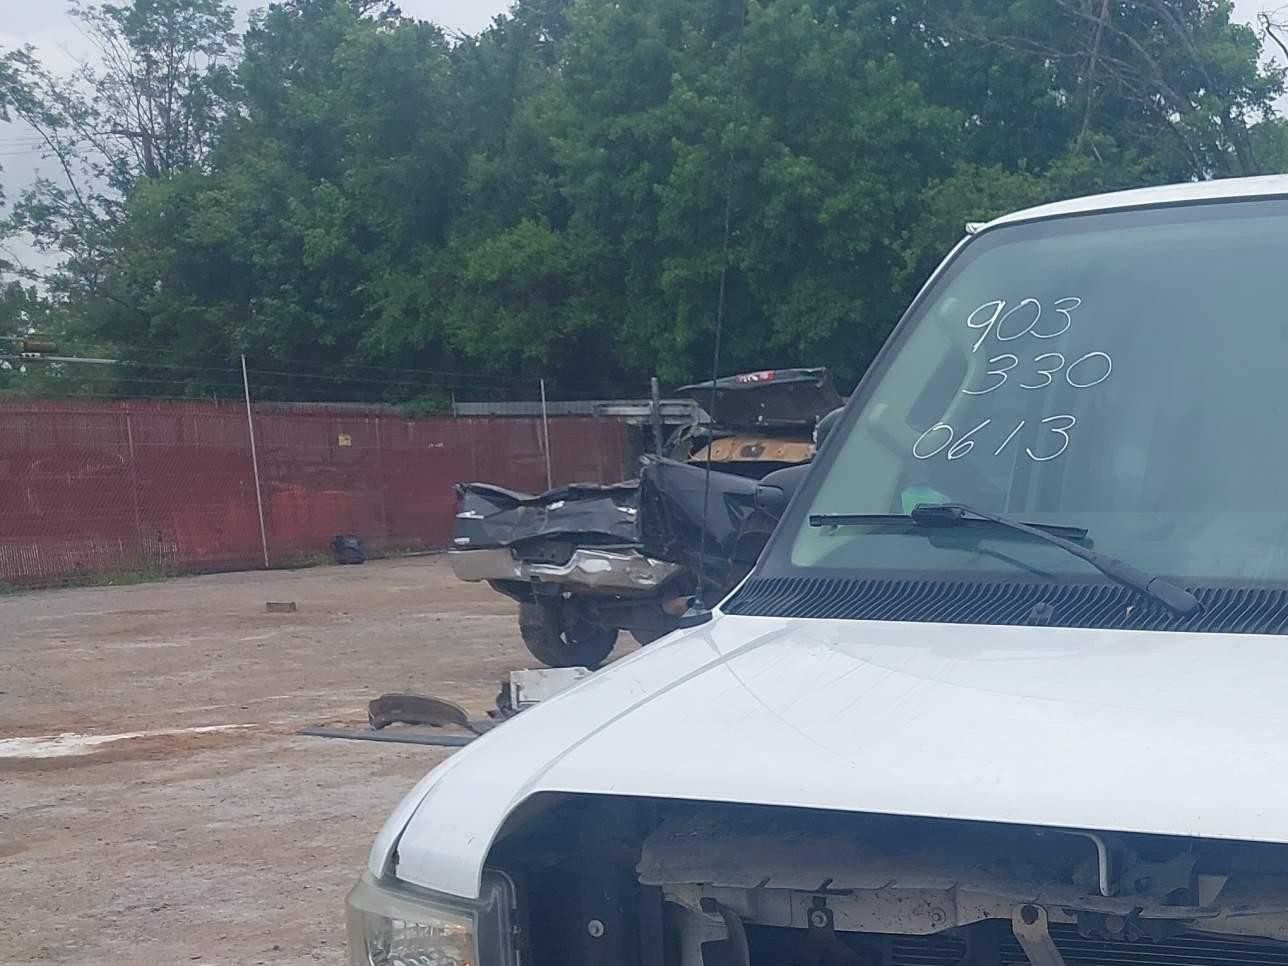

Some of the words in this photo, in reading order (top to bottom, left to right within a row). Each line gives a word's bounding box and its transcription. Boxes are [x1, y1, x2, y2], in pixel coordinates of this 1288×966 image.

[967, 297, 1082, 353] 903
[962, 352, 1112, 395] 330
[912, 414, 1076, 461] 0613
